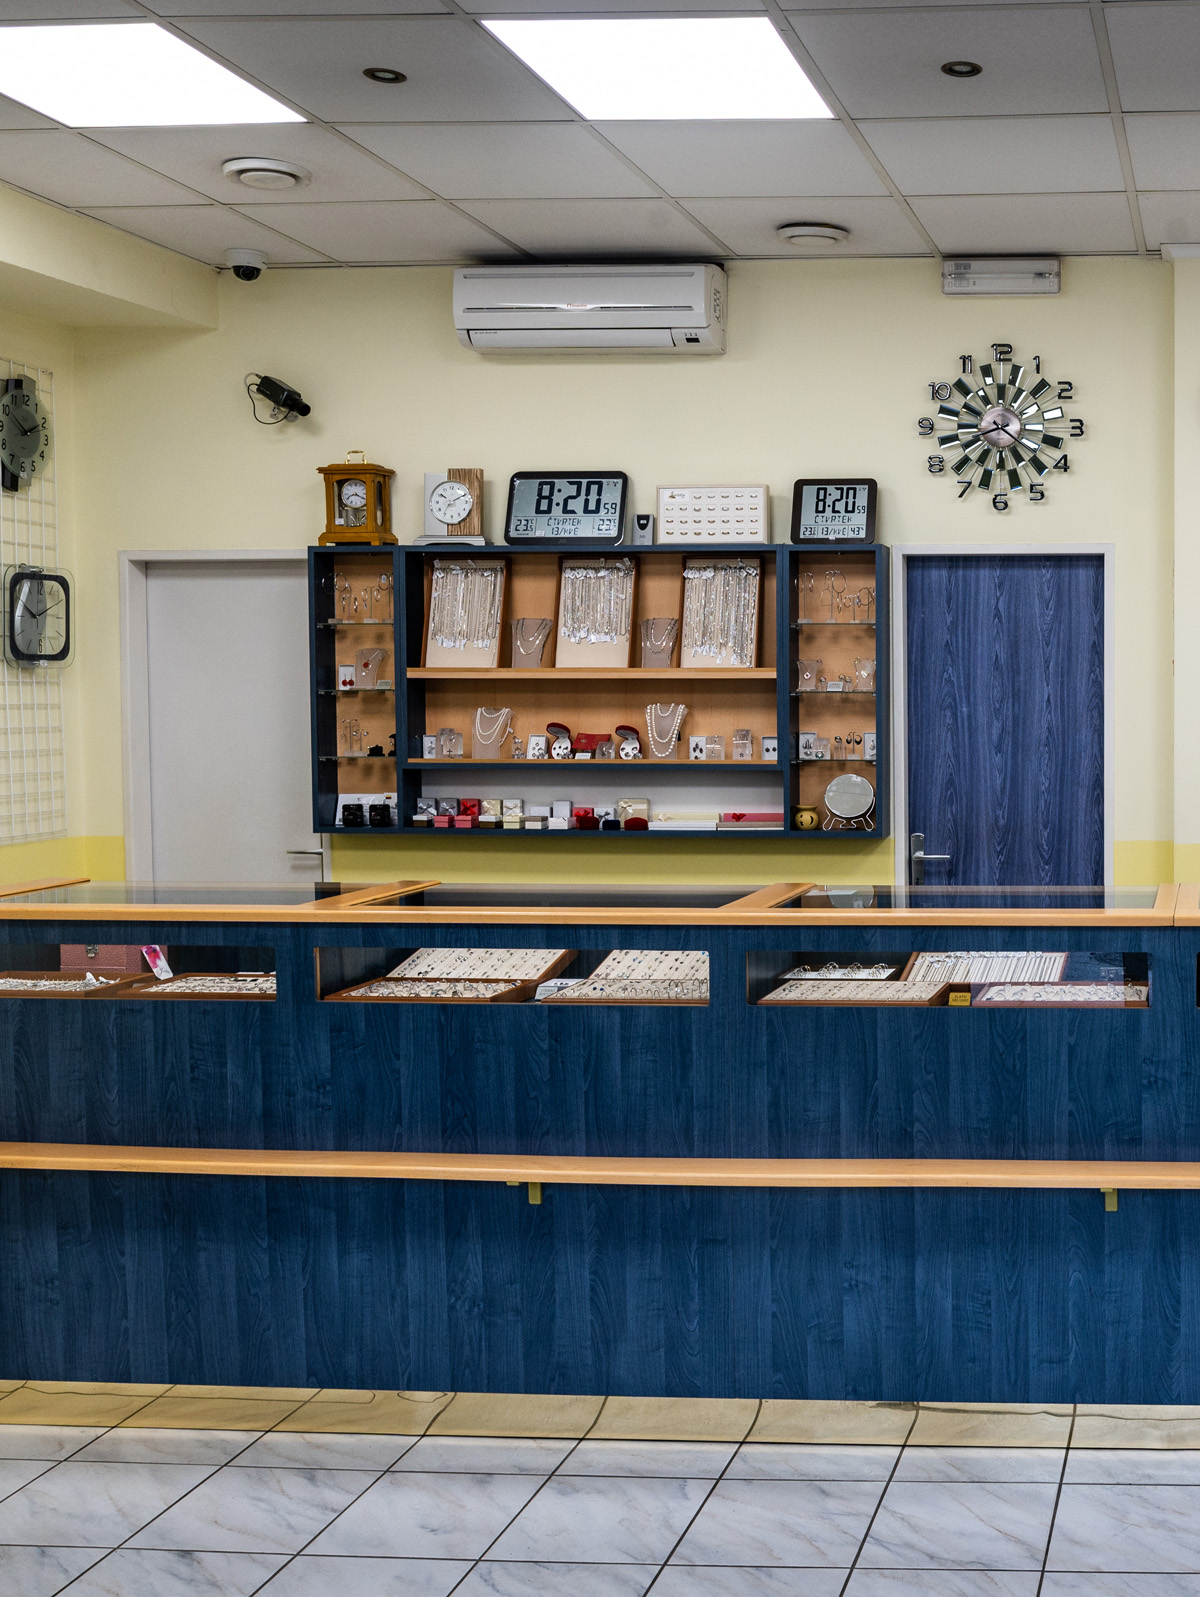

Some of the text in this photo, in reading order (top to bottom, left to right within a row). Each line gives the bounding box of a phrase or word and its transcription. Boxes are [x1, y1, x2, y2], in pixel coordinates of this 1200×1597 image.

[991, 344, 1012, 362] 12
[959, 355, 972, 373] 11
[1033, 356, 1040, 374] 1
[928, 382, 951, 400] 10
[1058, 381, 1073, 399] 2
[11, 394, 17, 406] 11
[23, 394, 30, 406] 12
[2, 404, 10, 416] 10
[35, 403, 38, 413] 1
[42, 417, 46, 428] 2
[918, 417, 934, 435] 9
[1070, 419, 1084, 437] 3
[2, 439, 6, 450] 8
[44, 435, 48, 446] 3
[9, 454, 14, 465] 7
[40, 451, 44, 461] 4
[1053, 454, 1069, 472] 4
[21, 462, 25, 472] 6
[31, 461, 35, 472] 5
[928, 455, 944, 473] 8
[957, 480, 972, 498] 7
[1030, 483, 1044, 500] 5
[535, 481, 603, 514] 8:20
[815, 487, 856, 513] 8:20
[993, 493, 1008, 510] 6
[603, 503, 617, 514] 59
[38, 581, 43, 595] 12
[39, 639, 42, 653] 6
